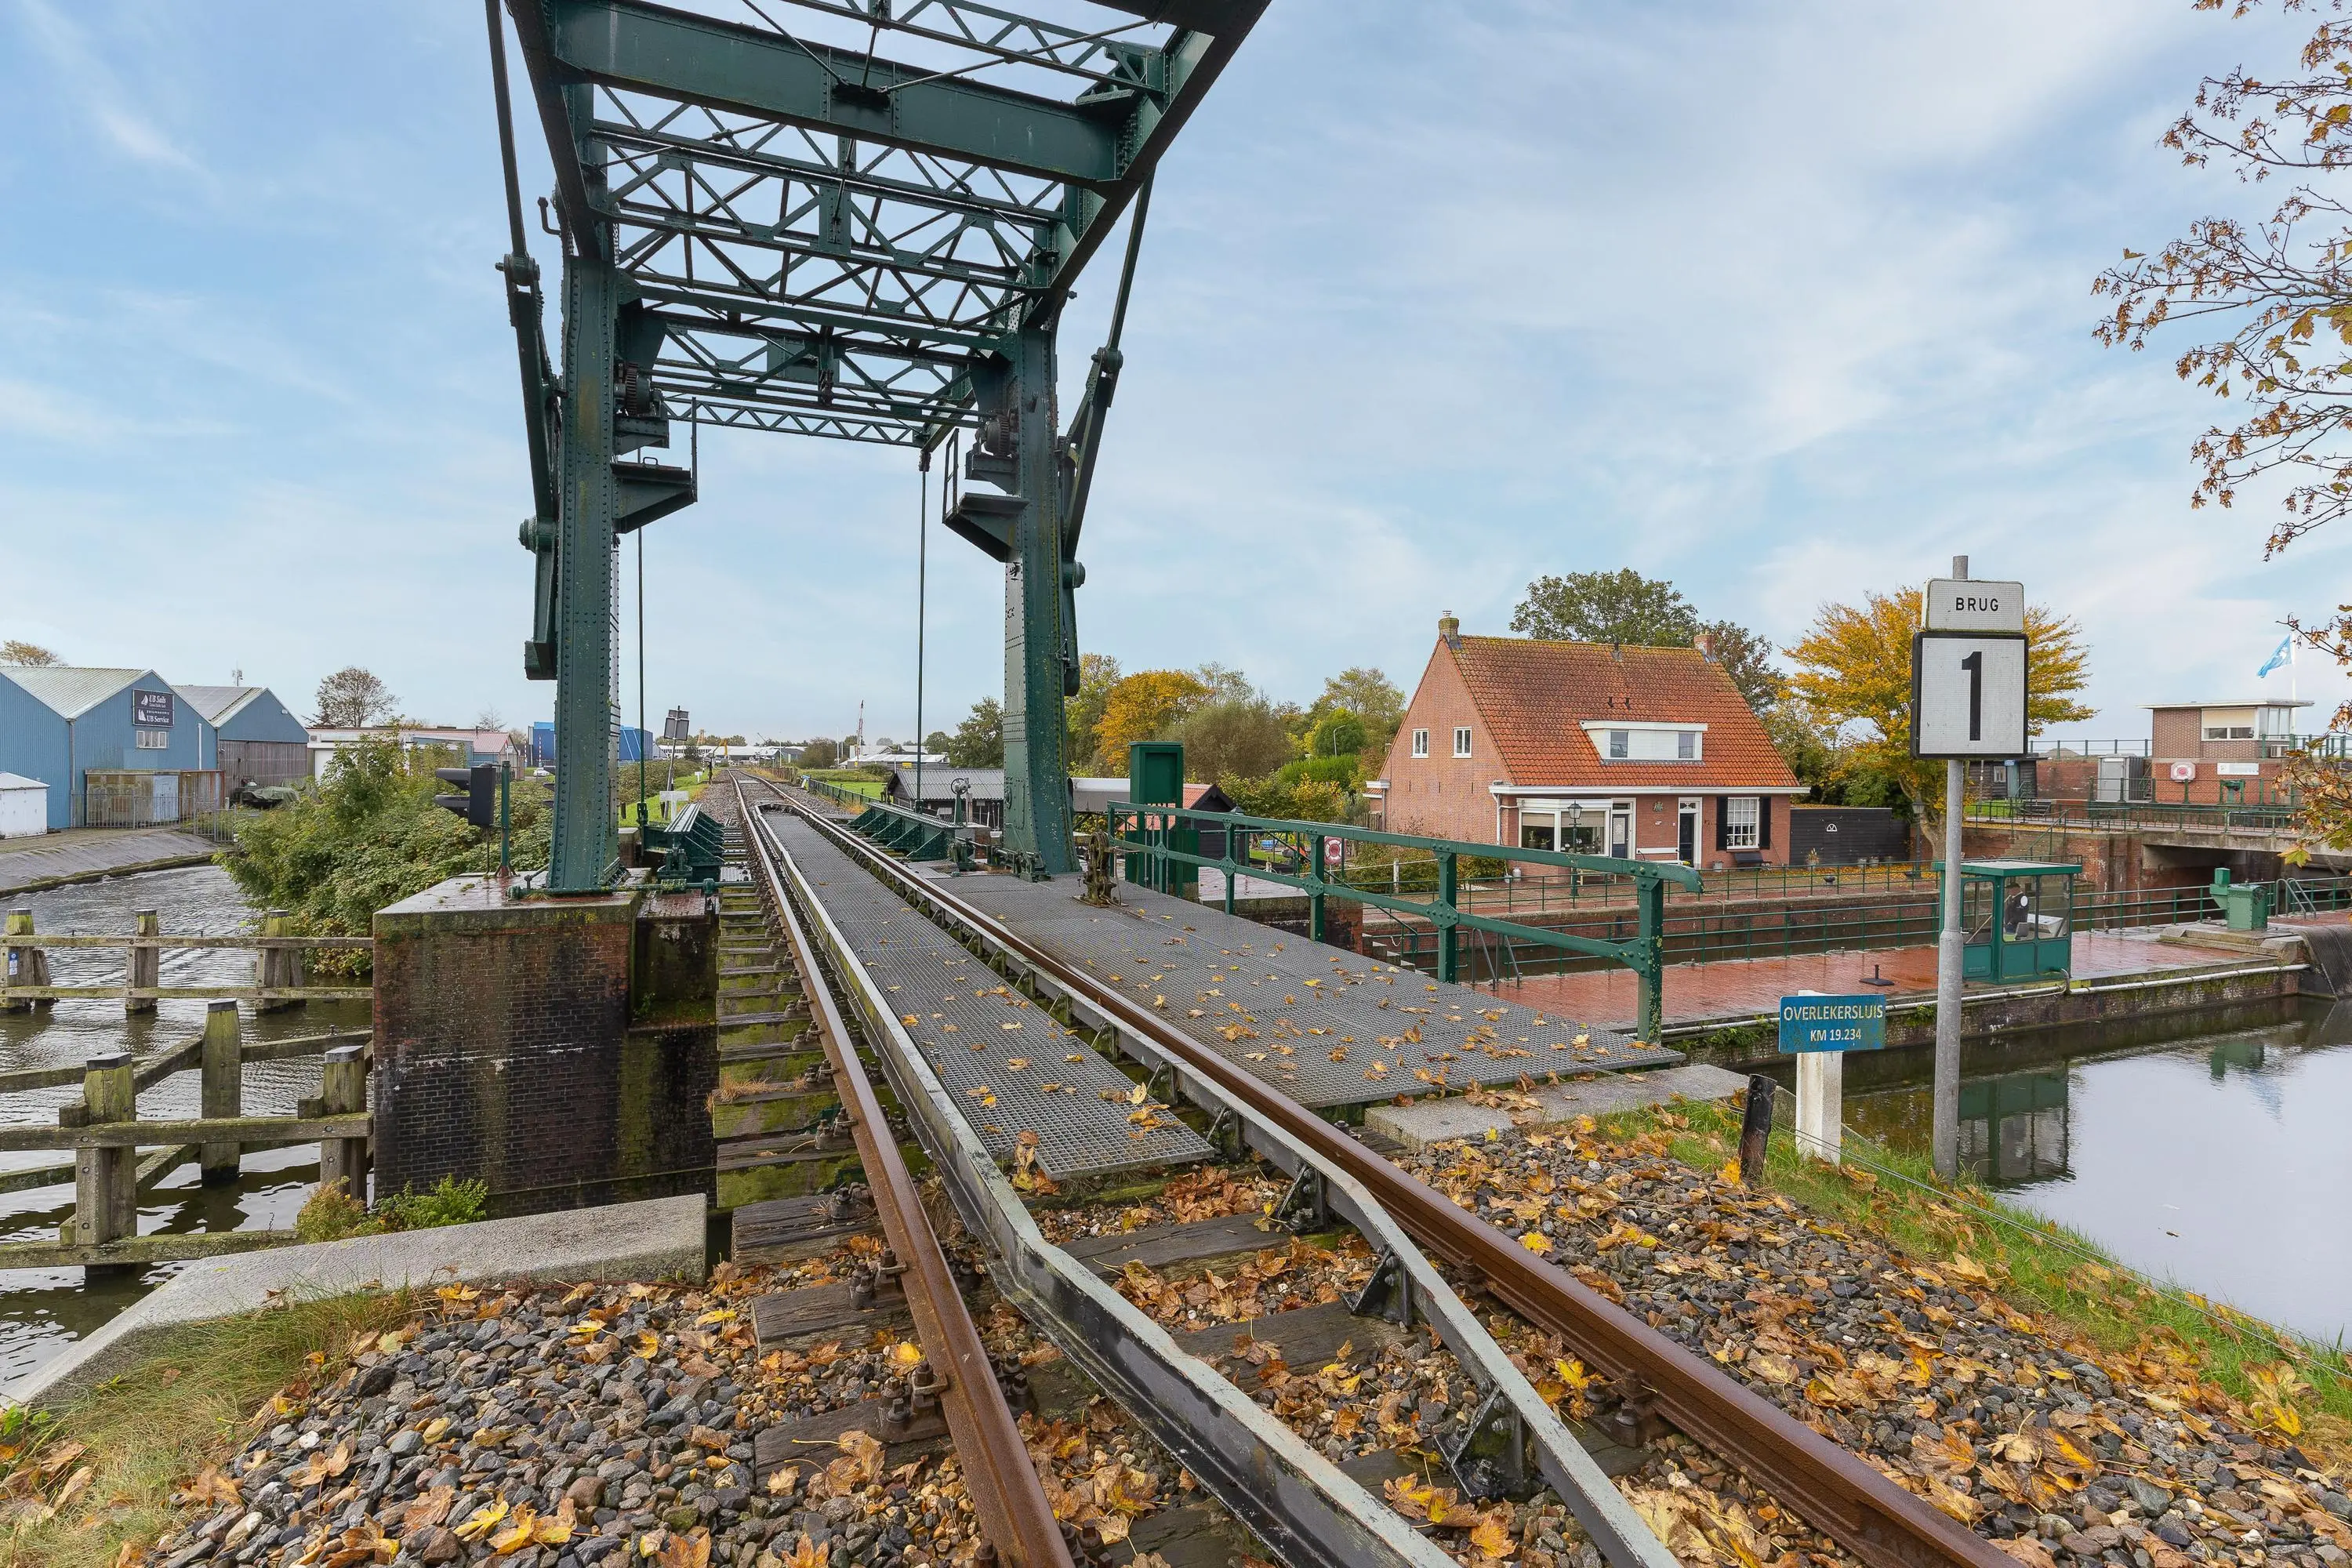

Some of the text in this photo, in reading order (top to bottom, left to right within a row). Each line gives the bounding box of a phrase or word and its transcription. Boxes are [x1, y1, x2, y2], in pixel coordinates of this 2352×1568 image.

[1956, 597, 1998, 612] BRUG
[1962, 652, 1982, 741] 1
[1784, 1004, 1883, 1021] OVERLEKERSLUIS
[1810, 1029, 1862, 1041] KM 19.234
